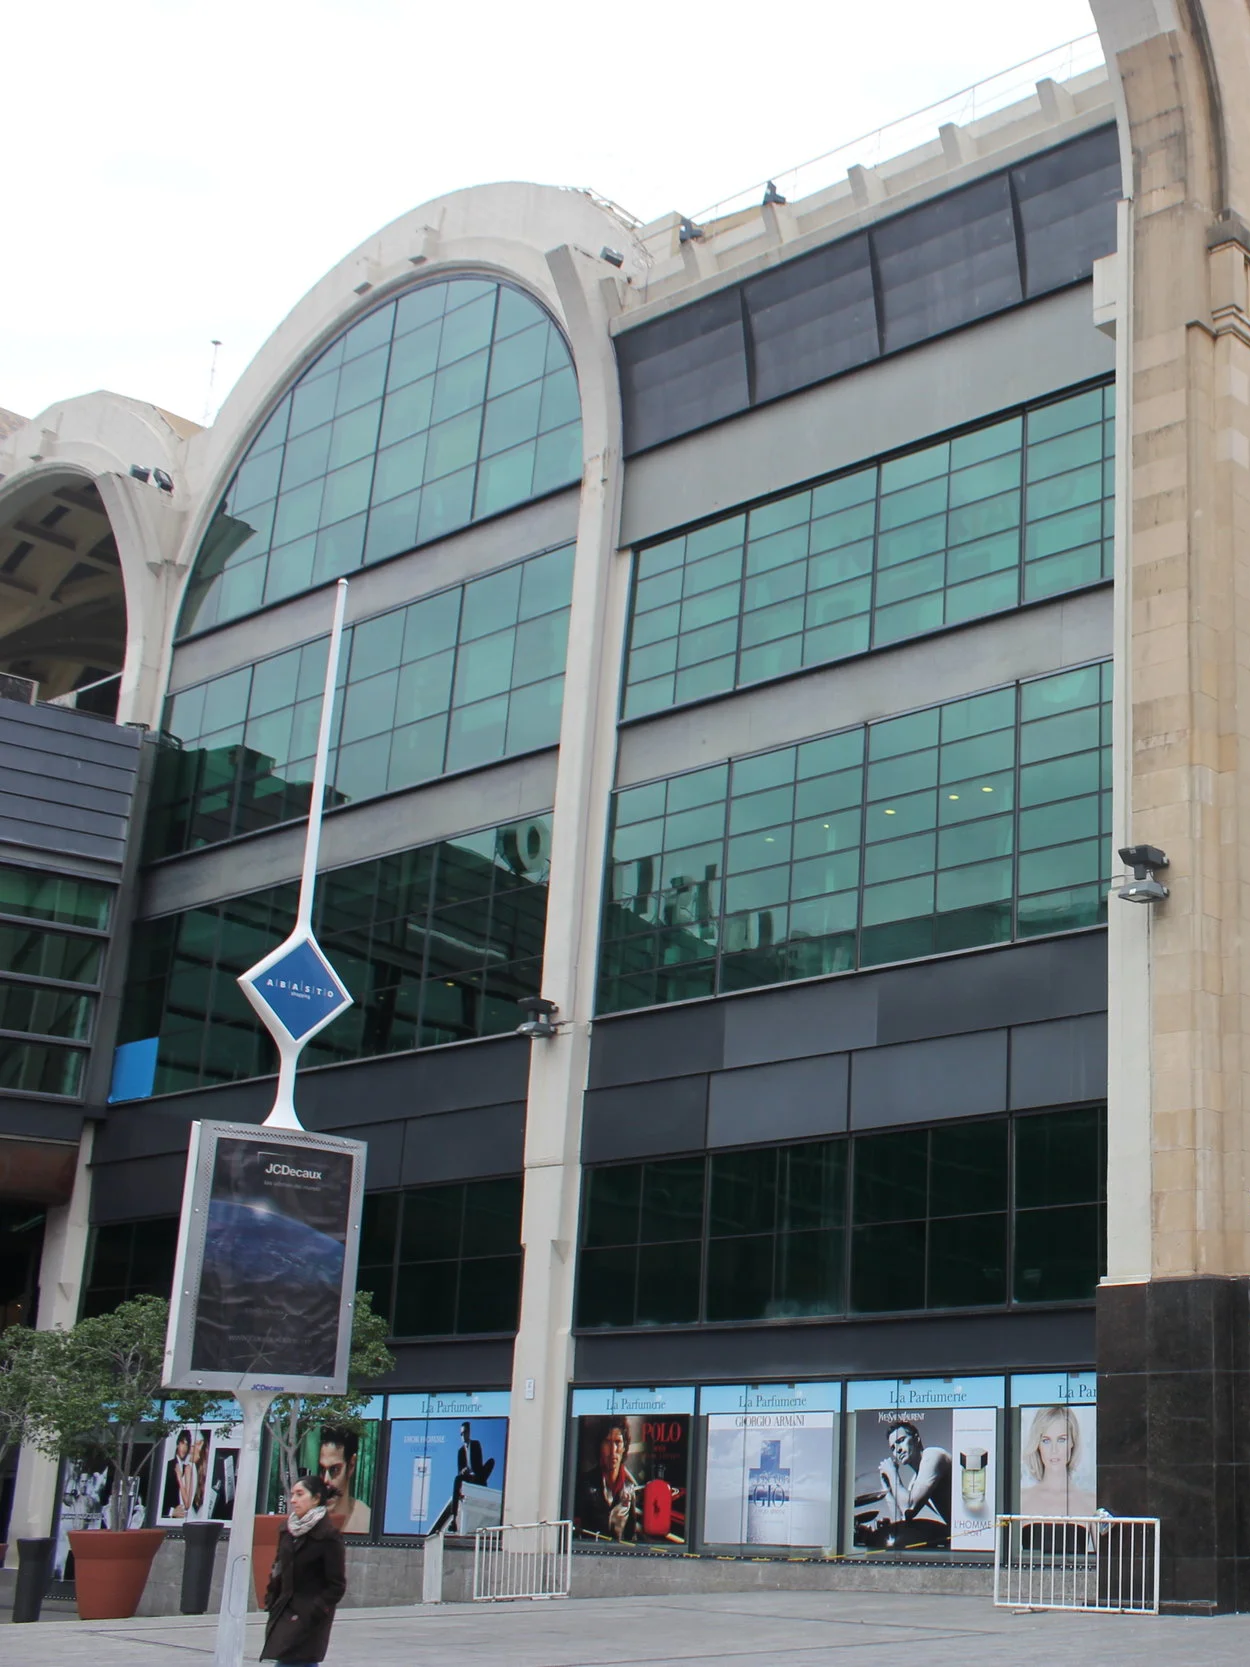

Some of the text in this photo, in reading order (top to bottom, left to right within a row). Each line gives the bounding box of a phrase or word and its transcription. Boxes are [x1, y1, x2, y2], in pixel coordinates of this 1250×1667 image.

[265, 1163, 322, 1180] JCDecaux
[890, 1389, 967, 1404] La Parfumerie
[1058, 1384, 1074, 1399] La
[421, 1400, 483, 1414] La Parfumerie
[606, 1398, 667, 1410] La Parfumerie
[739, 1394, 807, 1408] La Parfumerie
[735, 1414, 806, 1428] GIORGIO ARMANI
[641, 1422, 683, 1443] POLO
[954, 1520, 993, 1529] L'HOMME
